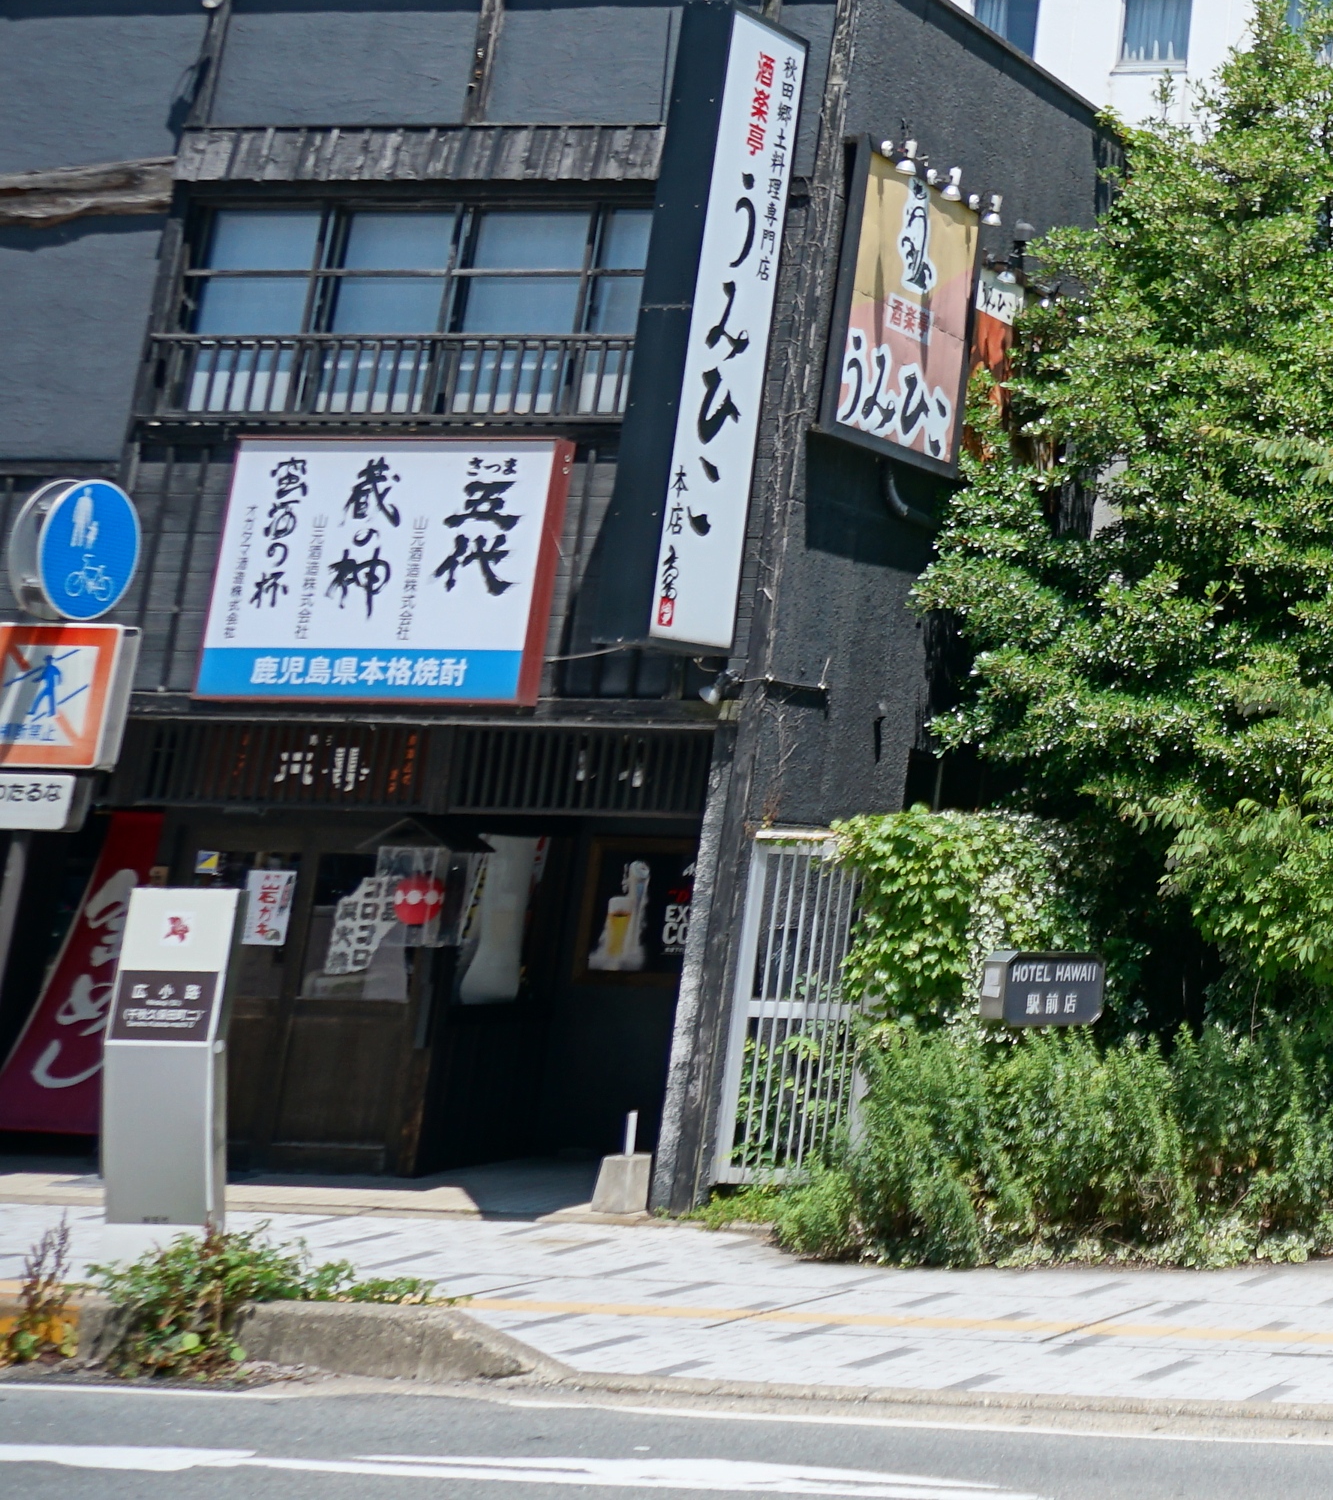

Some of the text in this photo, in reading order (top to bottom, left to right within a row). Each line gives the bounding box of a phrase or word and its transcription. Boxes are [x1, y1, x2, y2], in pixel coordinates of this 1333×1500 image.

[745, 51, 776, 157] 酒楽亭
[755, 55, 799, 282] 秋田郷土料理専門店
[888, 298, 931, 340] 酒楽亭
[467, 457, 519, 476] さつま
[665, 465, 690, 535] 本店
[326, 456, 401, 620] 蔵の神
[434, 481, 521, 597] 五代
[251, 655, 468, 687] 鹿児島県本格焼酎
[1012, 964, 1097, 983] HOTEL HAWAII
[1025, 992, 1078, 1015] 駅前店
